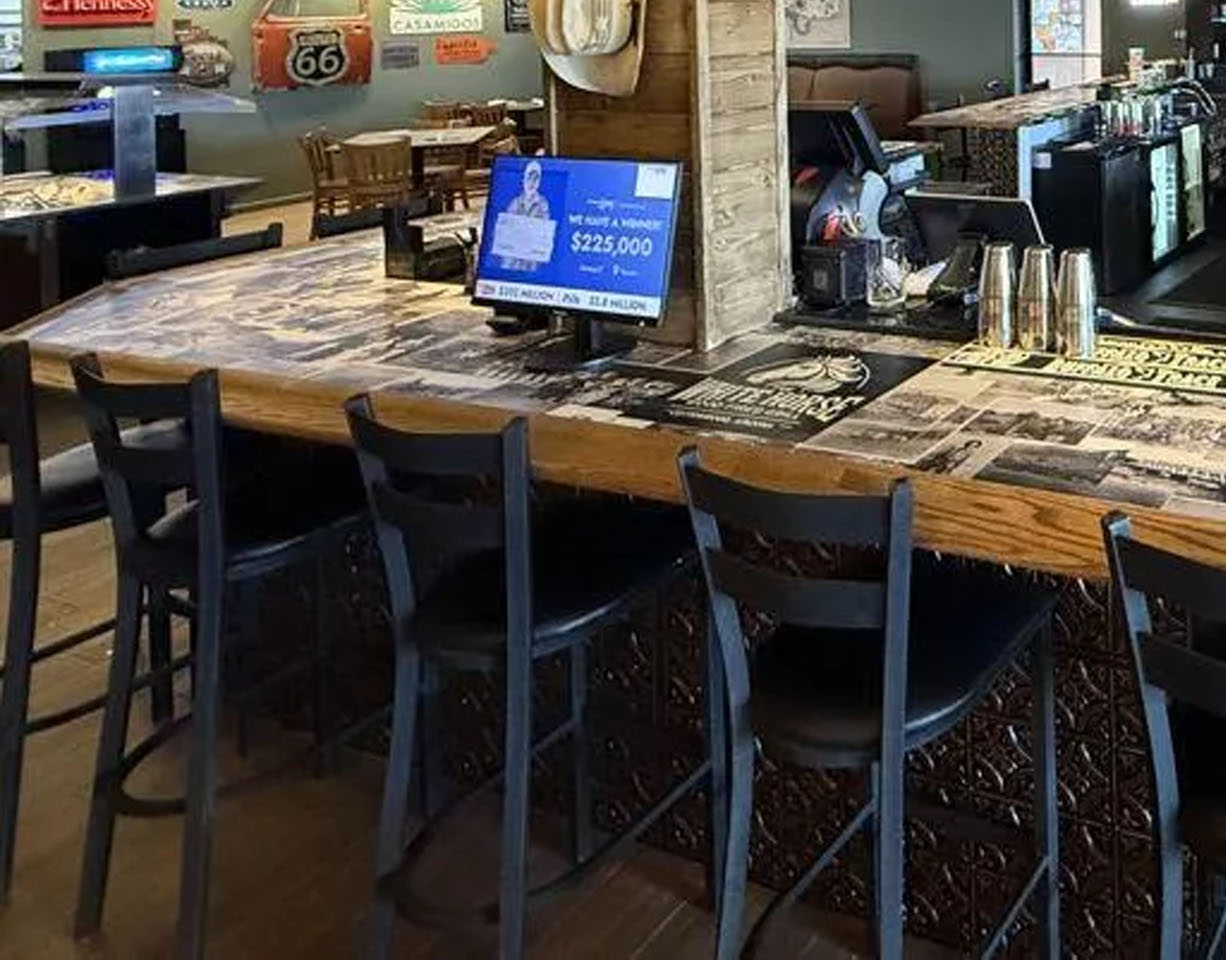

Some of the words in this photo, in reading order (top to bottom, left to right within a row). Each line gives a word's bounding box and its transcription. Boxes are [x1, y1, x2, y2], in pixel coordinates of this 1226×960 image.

[393, 17, 481, 31] CASAMIGOS
[296, 47, 339, 75] 66
[571, 231, 653, 256] $225,000
[757, 390, 866, 423] HORSE
